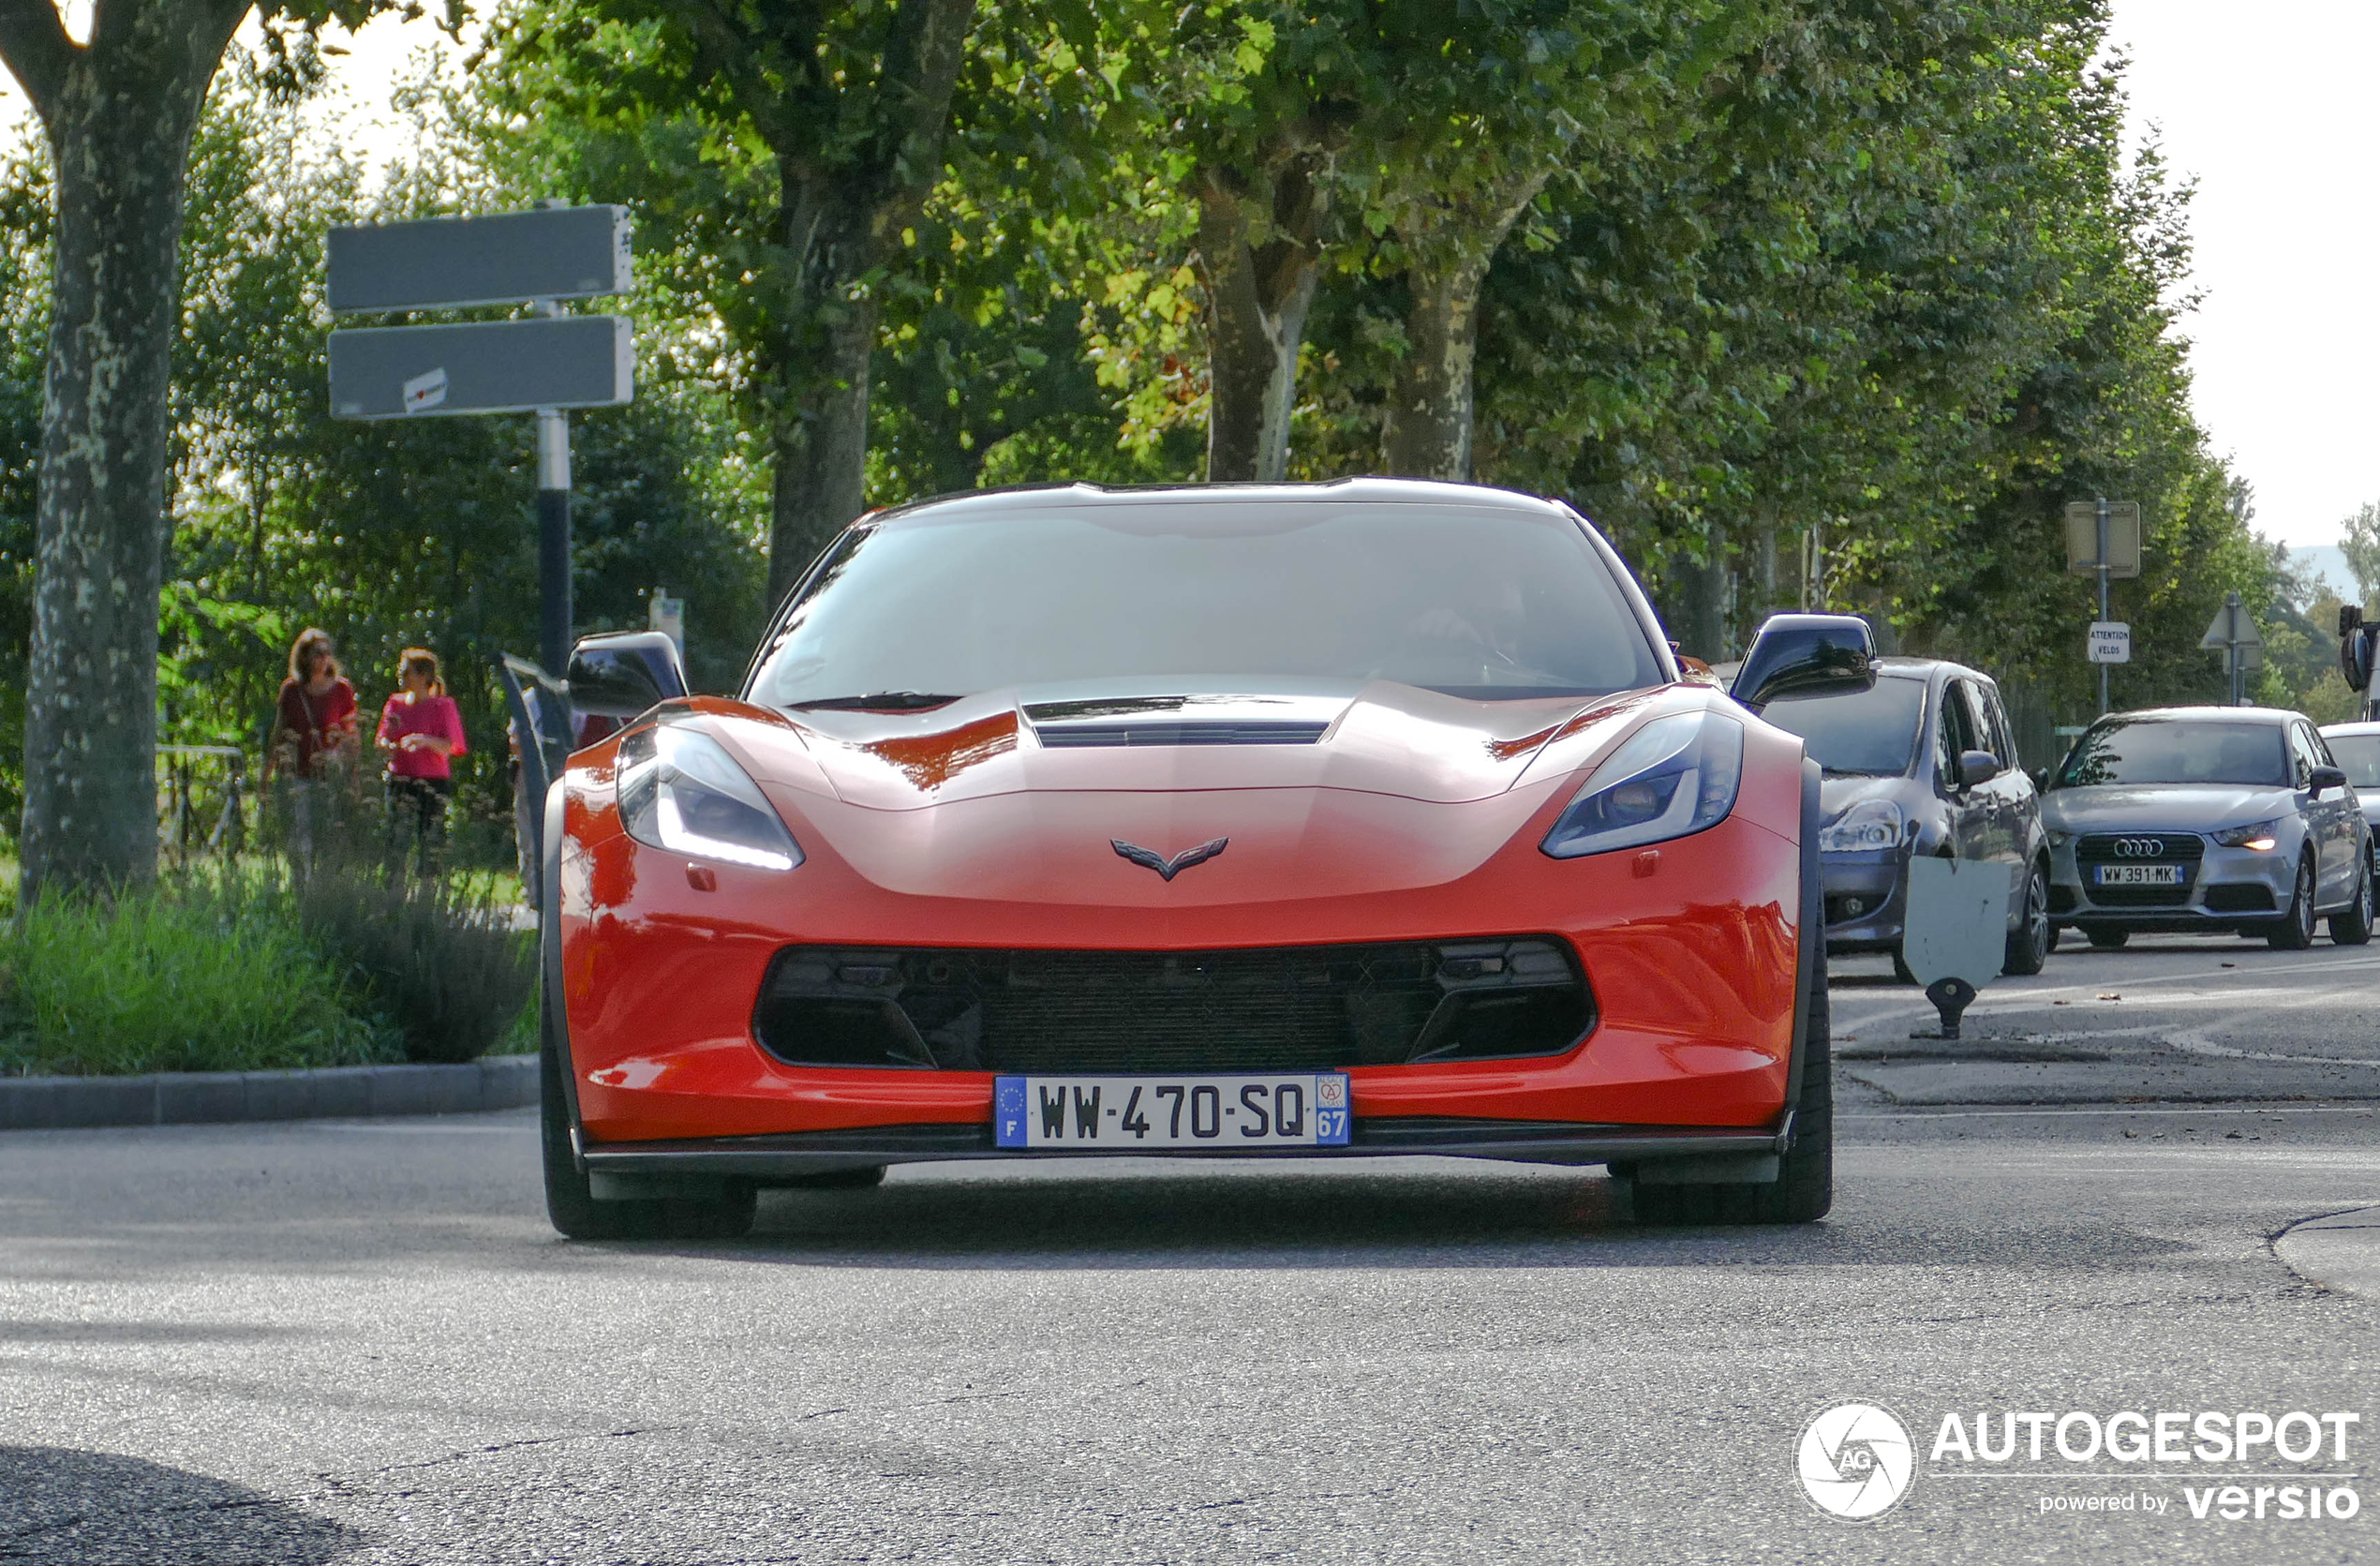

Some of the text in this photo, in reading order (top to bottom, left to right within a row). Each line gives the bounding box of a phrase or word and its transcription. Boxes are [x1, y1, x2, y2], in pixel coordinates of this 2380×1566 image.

[2090, 631, 2128, 640] ATTENTION
[2098, 646, 2120, 654] VELOS
[1038, 1083, 1304, 1139] WW-470-SQ
[1006, 1121, 1017, 1138] F
[1317, 1111, 1346, 1137] 67
